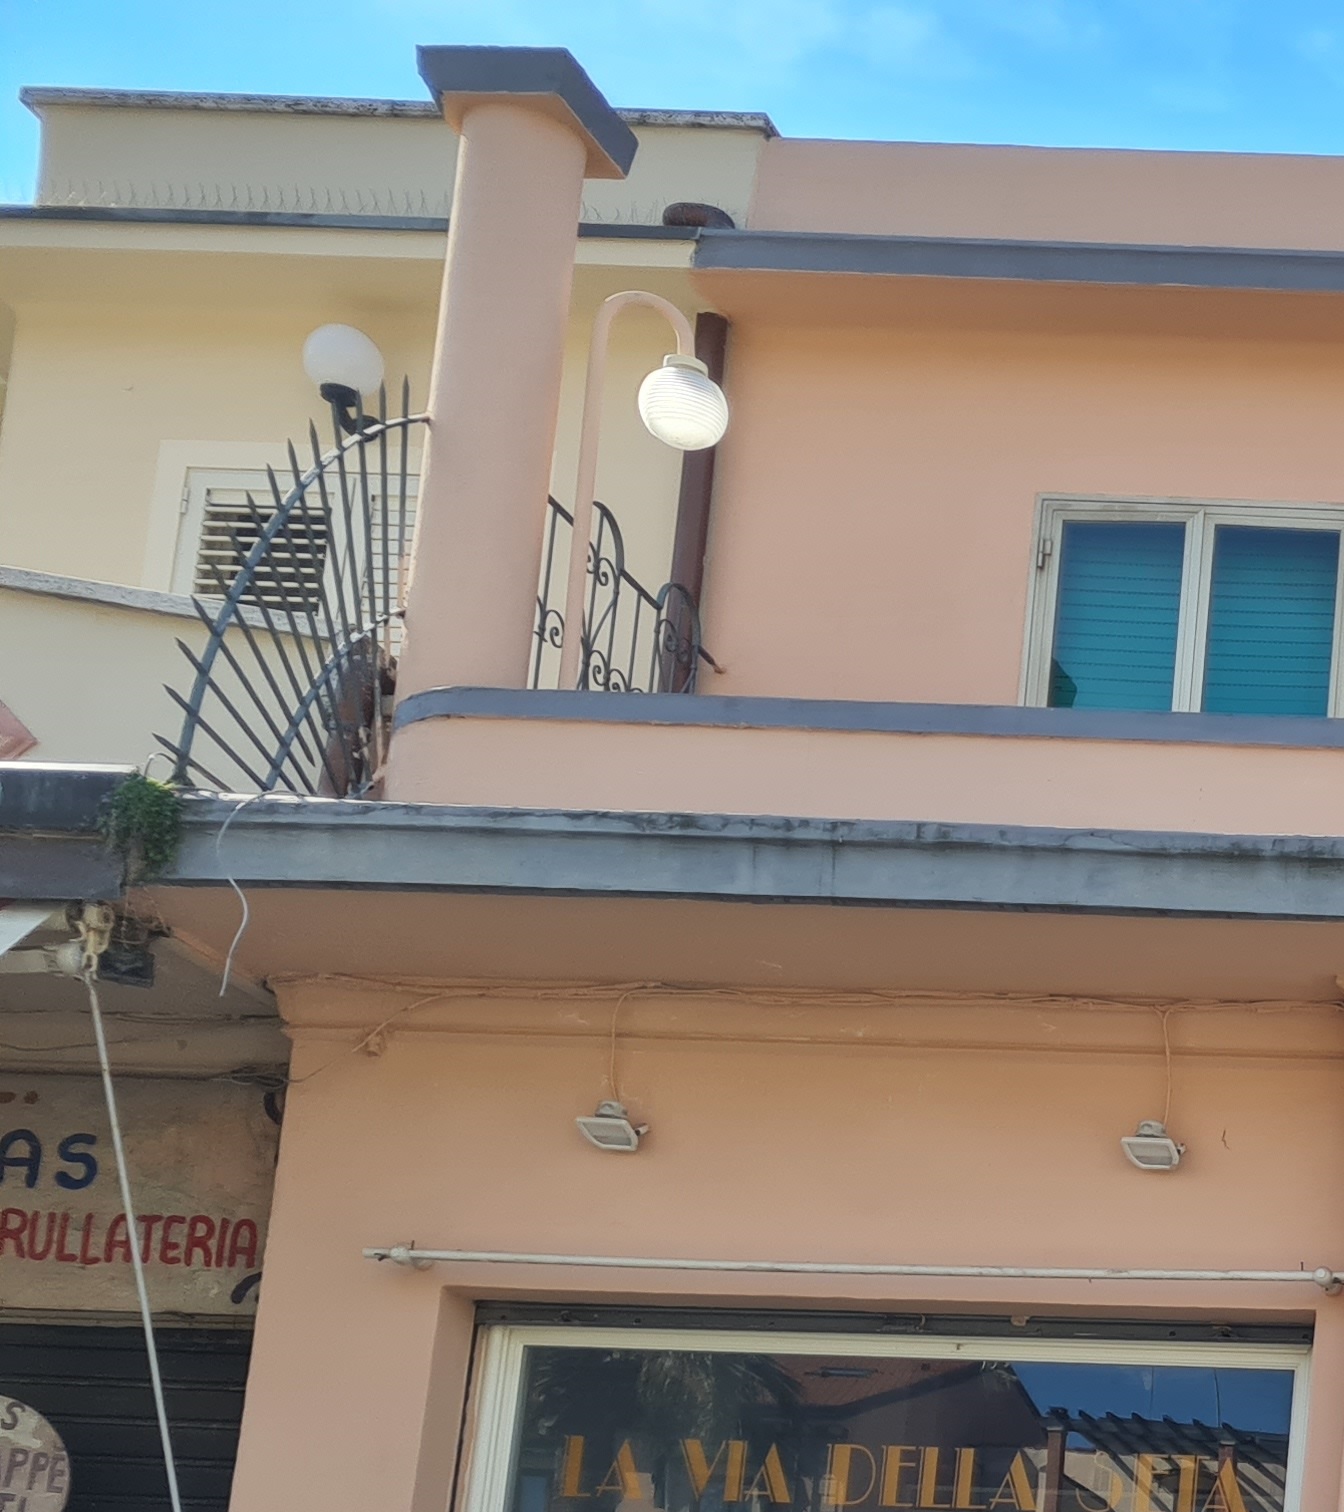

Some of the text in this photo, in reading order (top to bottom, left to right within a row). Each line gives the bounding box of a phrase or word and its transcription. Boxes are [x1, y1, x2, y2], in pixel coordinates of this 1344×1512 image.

[560, 1435, 644, 1500] LA
[679, 1437, 791, 1504] VIA
[826, 1442, 1037, 1512] DELLA
